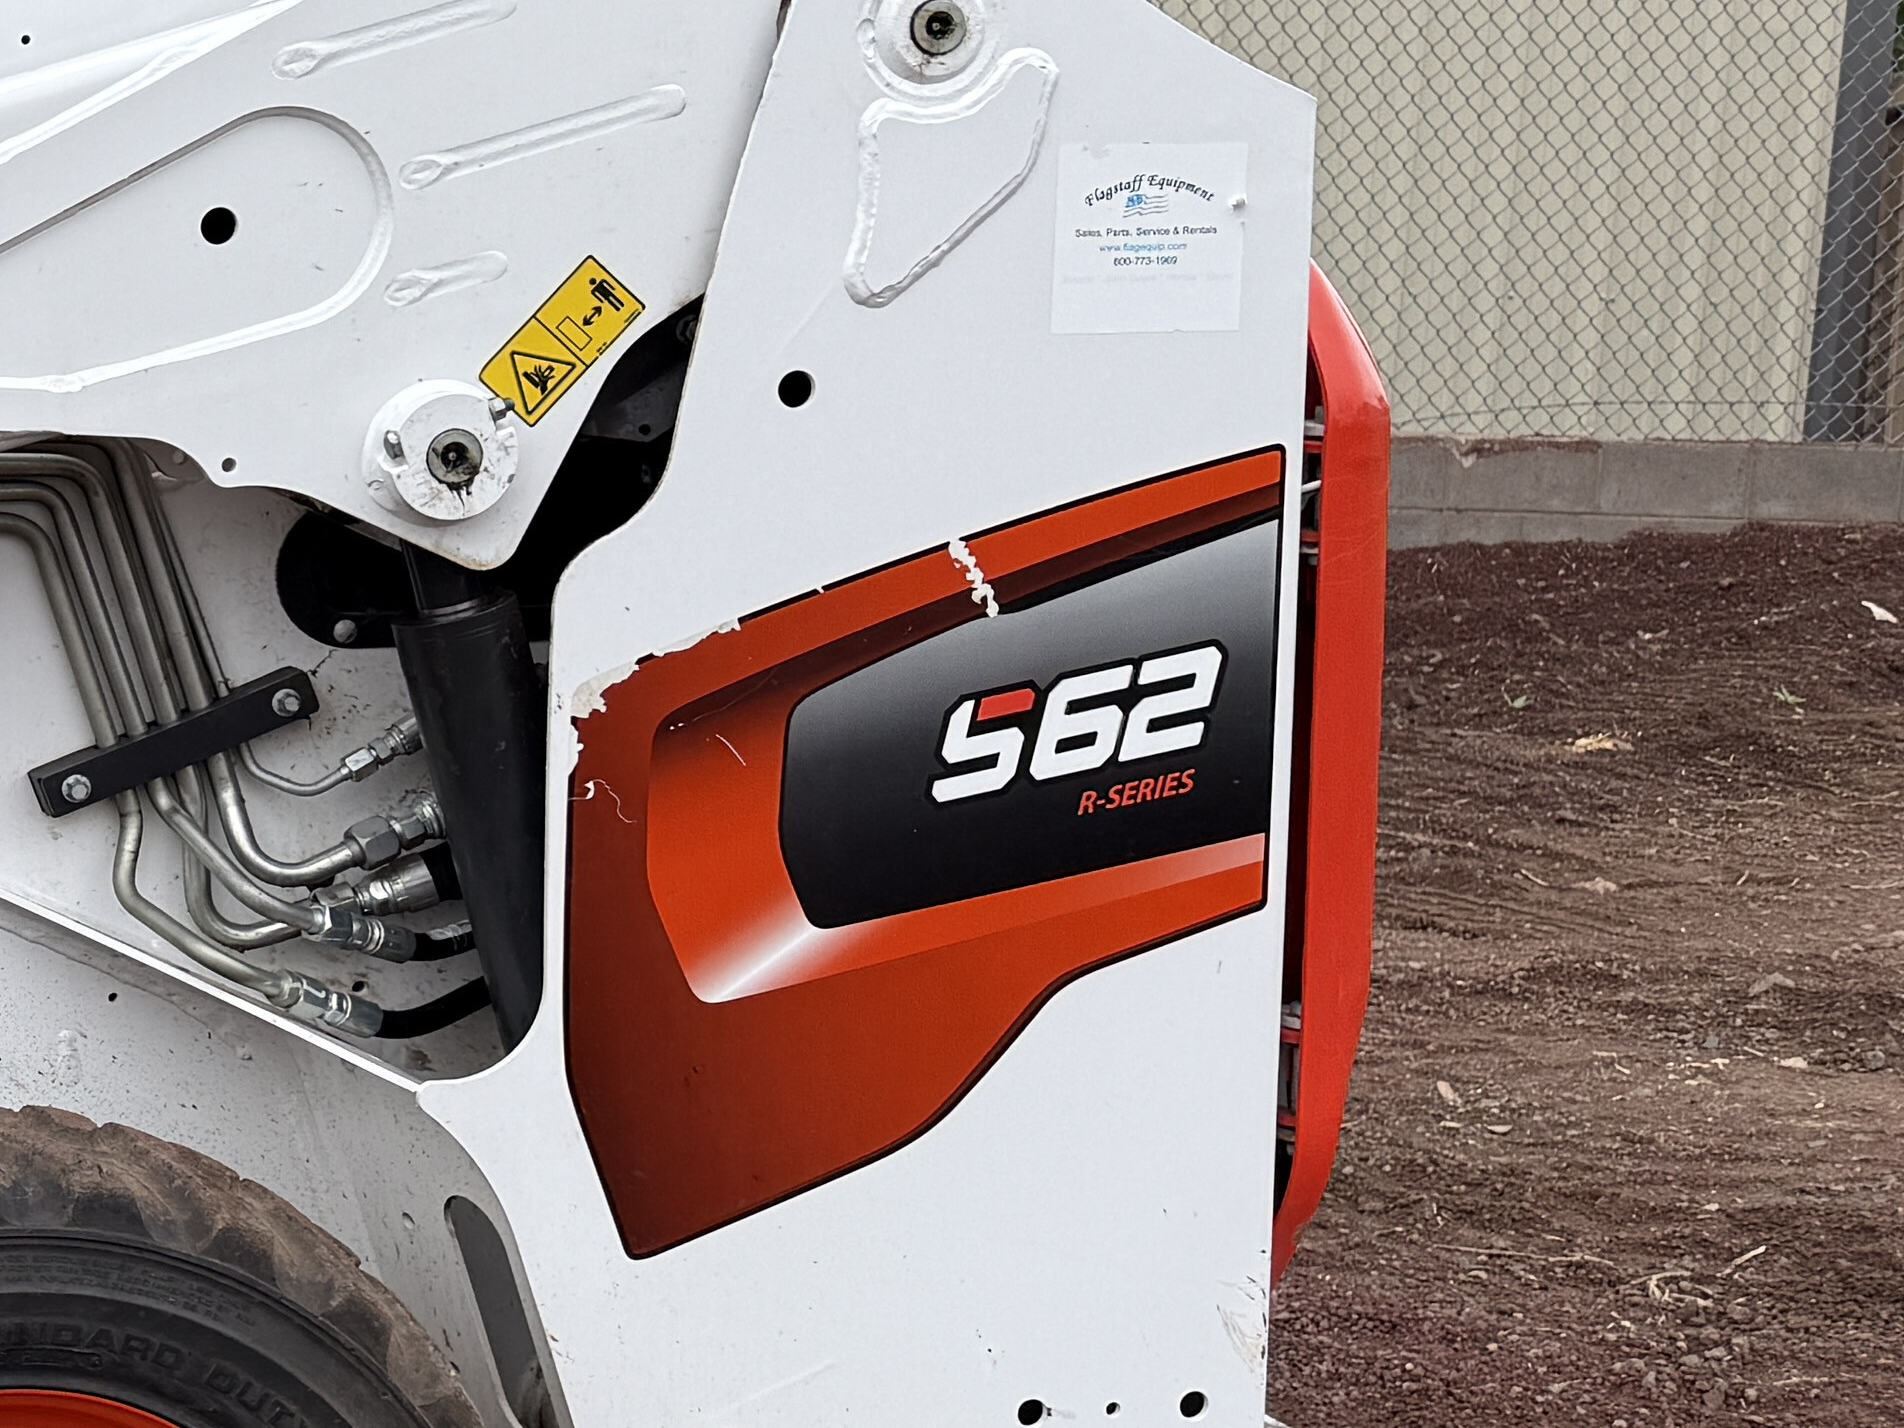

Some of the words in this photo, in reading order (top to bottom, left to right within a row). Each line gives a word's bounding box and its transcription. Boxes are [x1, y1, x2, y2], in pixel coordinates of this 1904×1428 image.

[1085, 174, 1145, 207] Flagstaff
[1147, 174, 1216, 201] Equipment
[932, 645, 1223, 803] S62
[1078, 769, 1195, 816] R-SERIES
